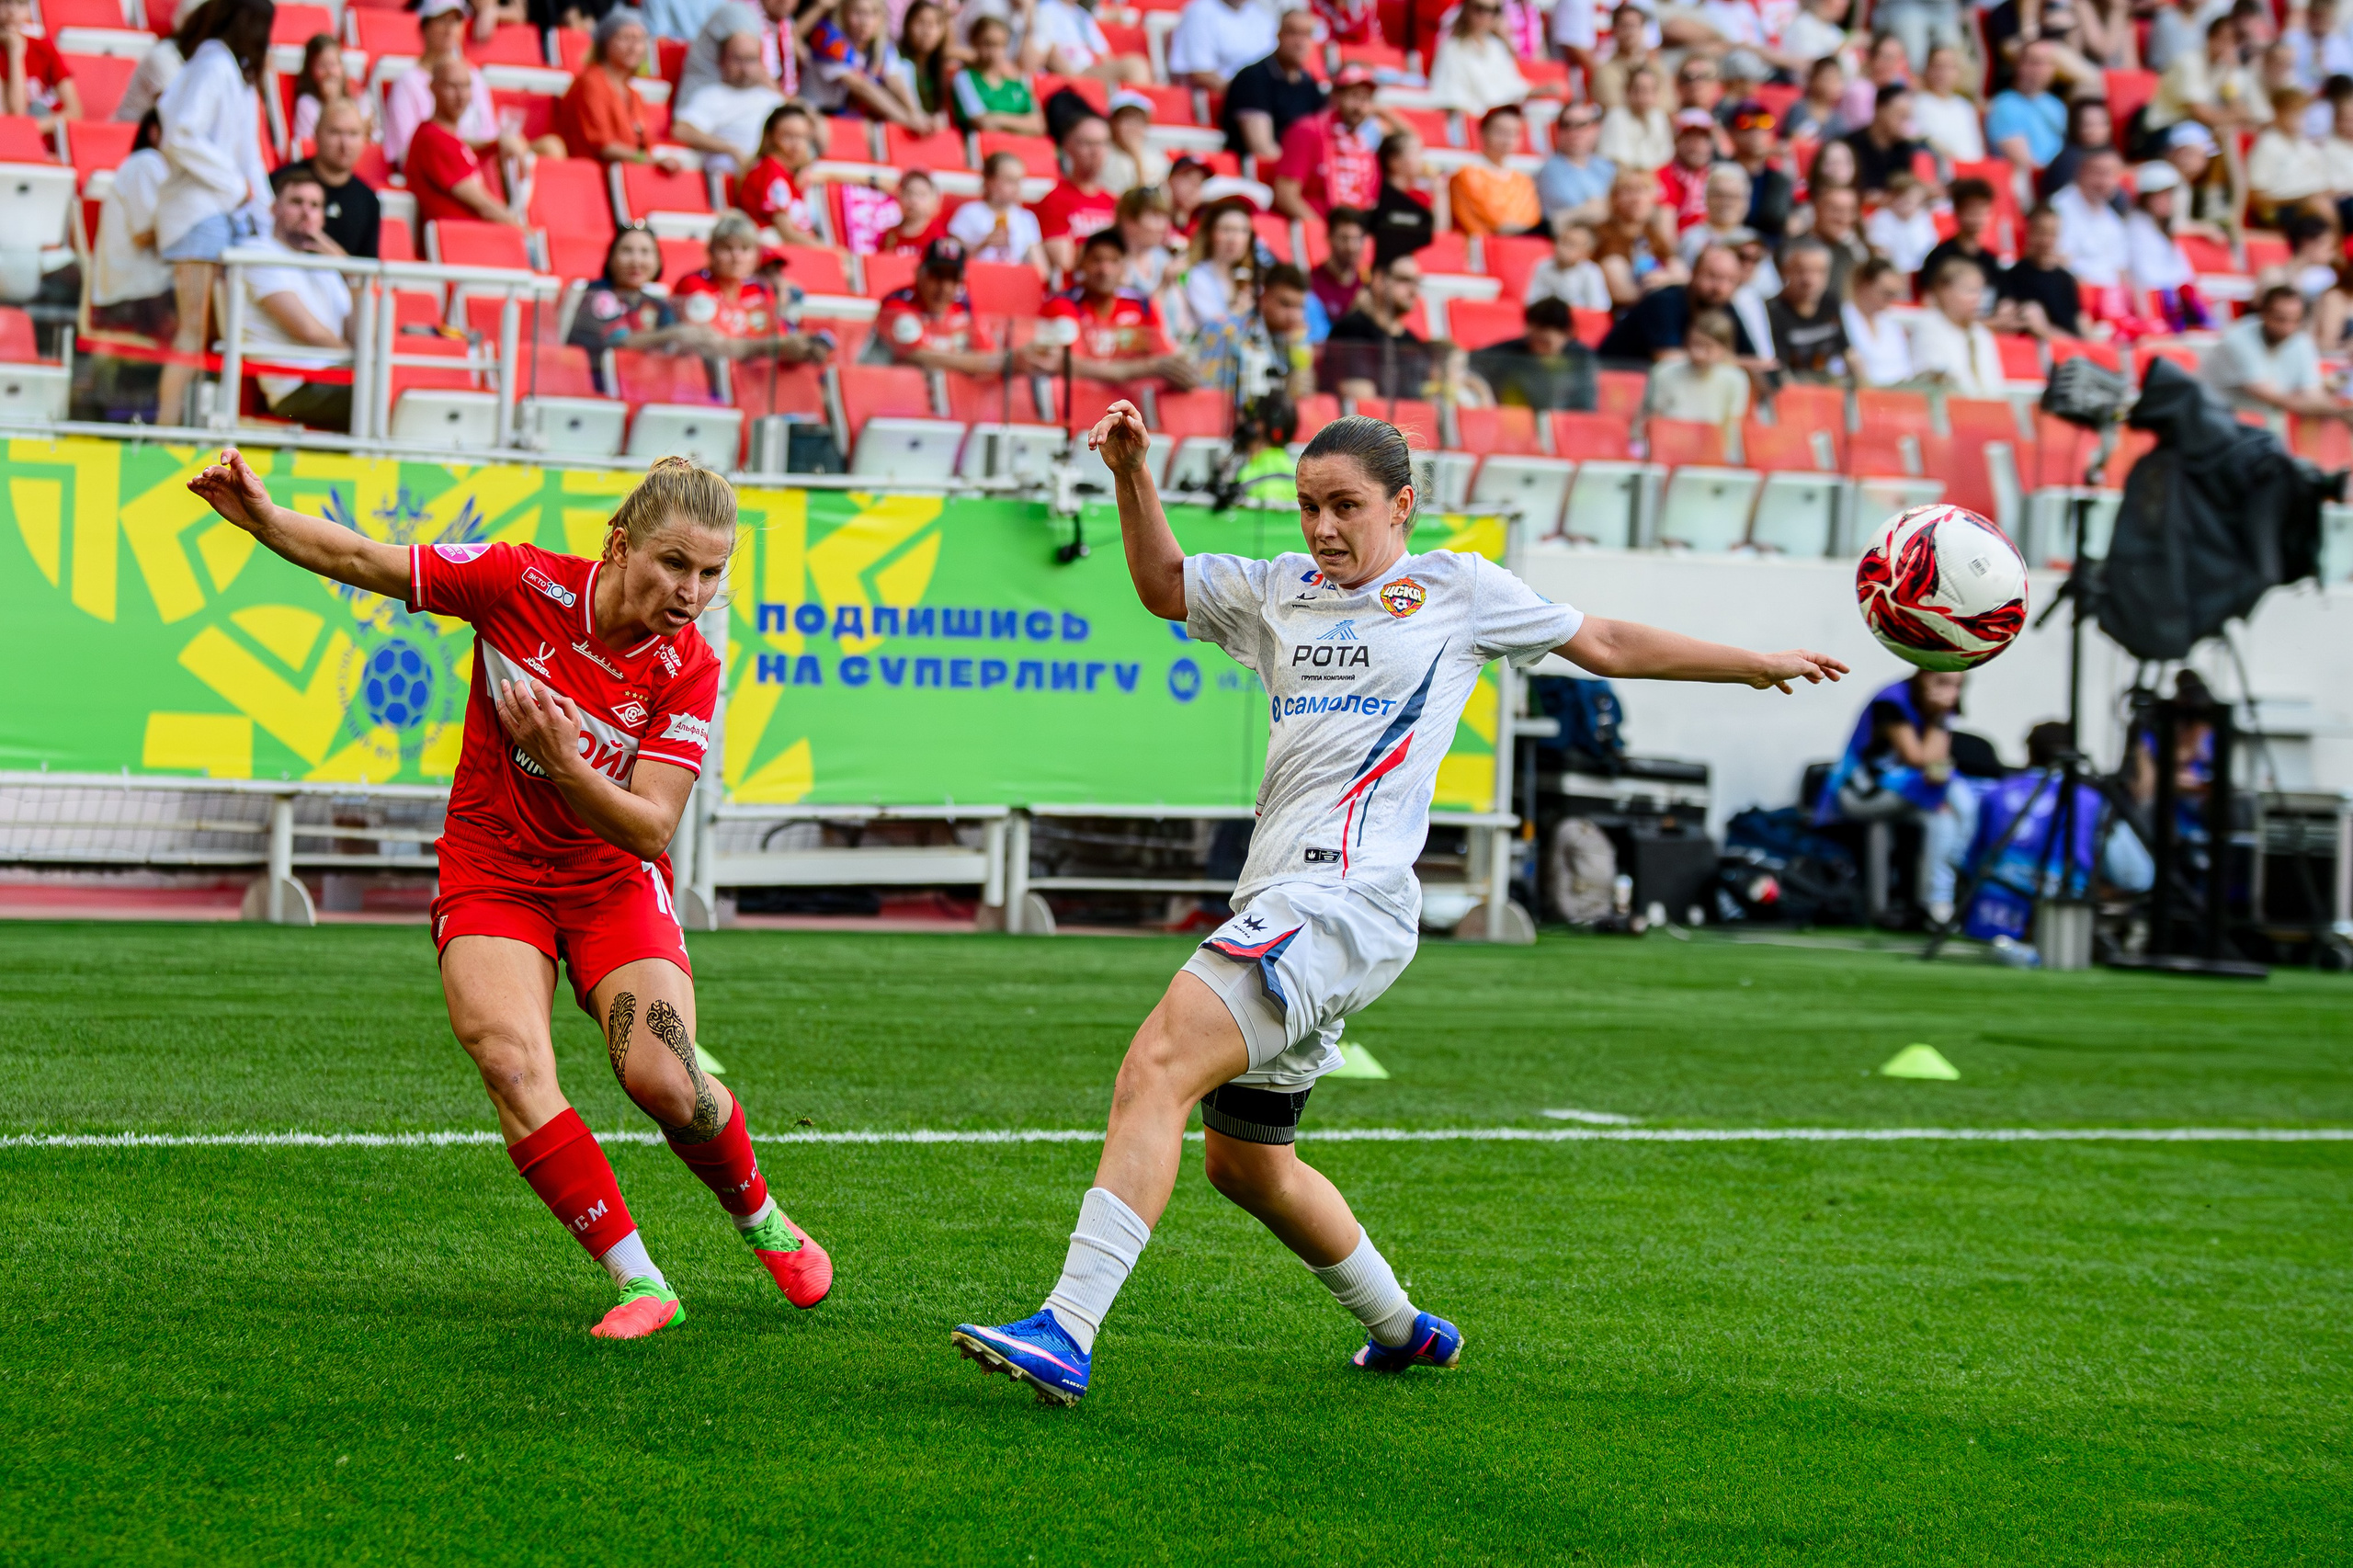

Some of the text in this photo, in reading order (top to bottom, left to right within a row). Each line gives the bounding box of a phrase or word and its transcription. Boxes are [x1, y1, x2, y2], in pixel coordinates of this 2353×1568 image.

[527, 572, 547, 587] ЭКТО
[1383, 585, 1422, 602] ЦСКА
[757, 603, 1090, 642] ПОДПИШИСЬ
[1292, 645, 1370, 667] РОТА
[757, 653, 822, 686] НА
[1284, 694, 1397, 716] самолет
[674, 722, 699, 735] Альфа
